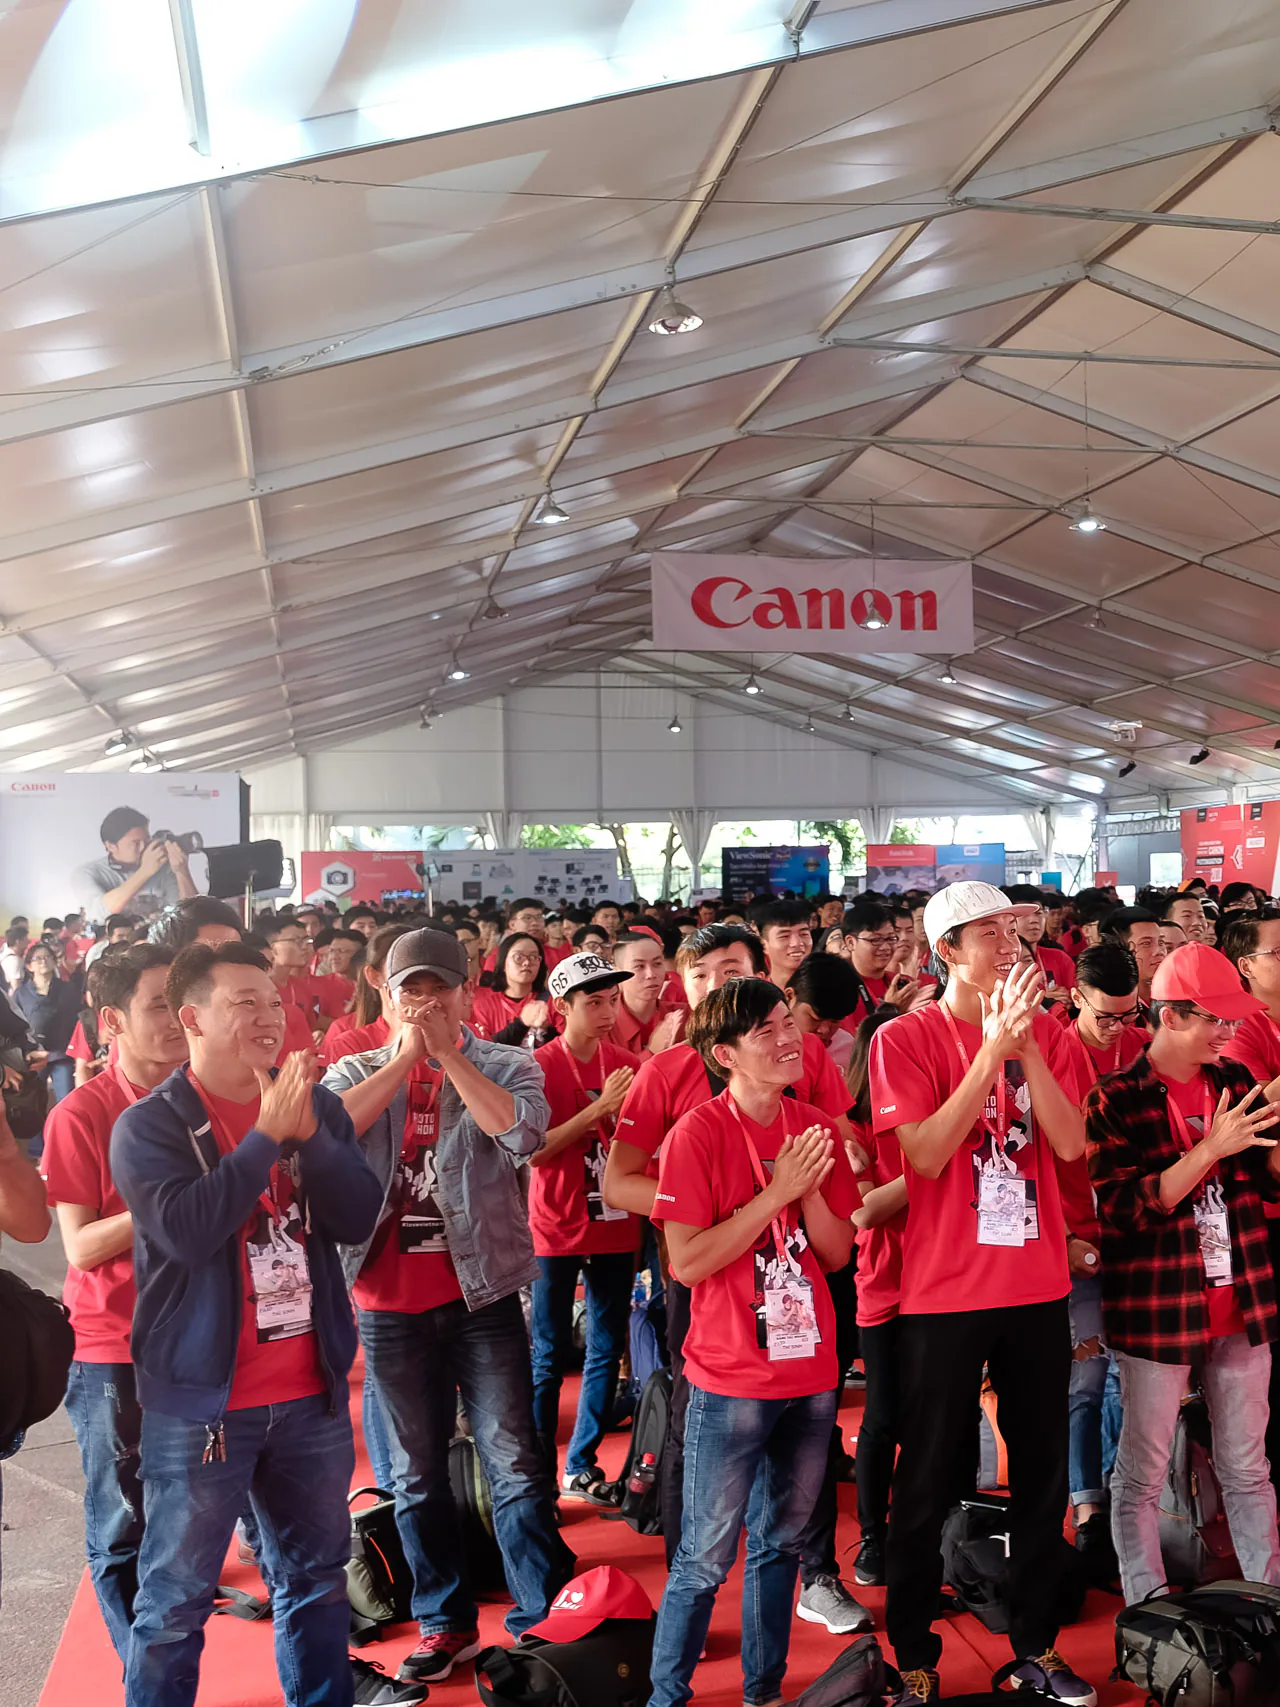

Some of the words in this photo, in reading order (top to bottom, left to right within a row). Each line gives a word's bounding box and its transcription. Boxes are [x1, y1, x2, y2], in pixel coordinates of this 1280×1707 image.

[691, 576, 938, 631] Canon
[11, 782, 57, 792] Canon
[728, 850, 772, 860] ViewSonic
[551, 972, 568, 994] 66
